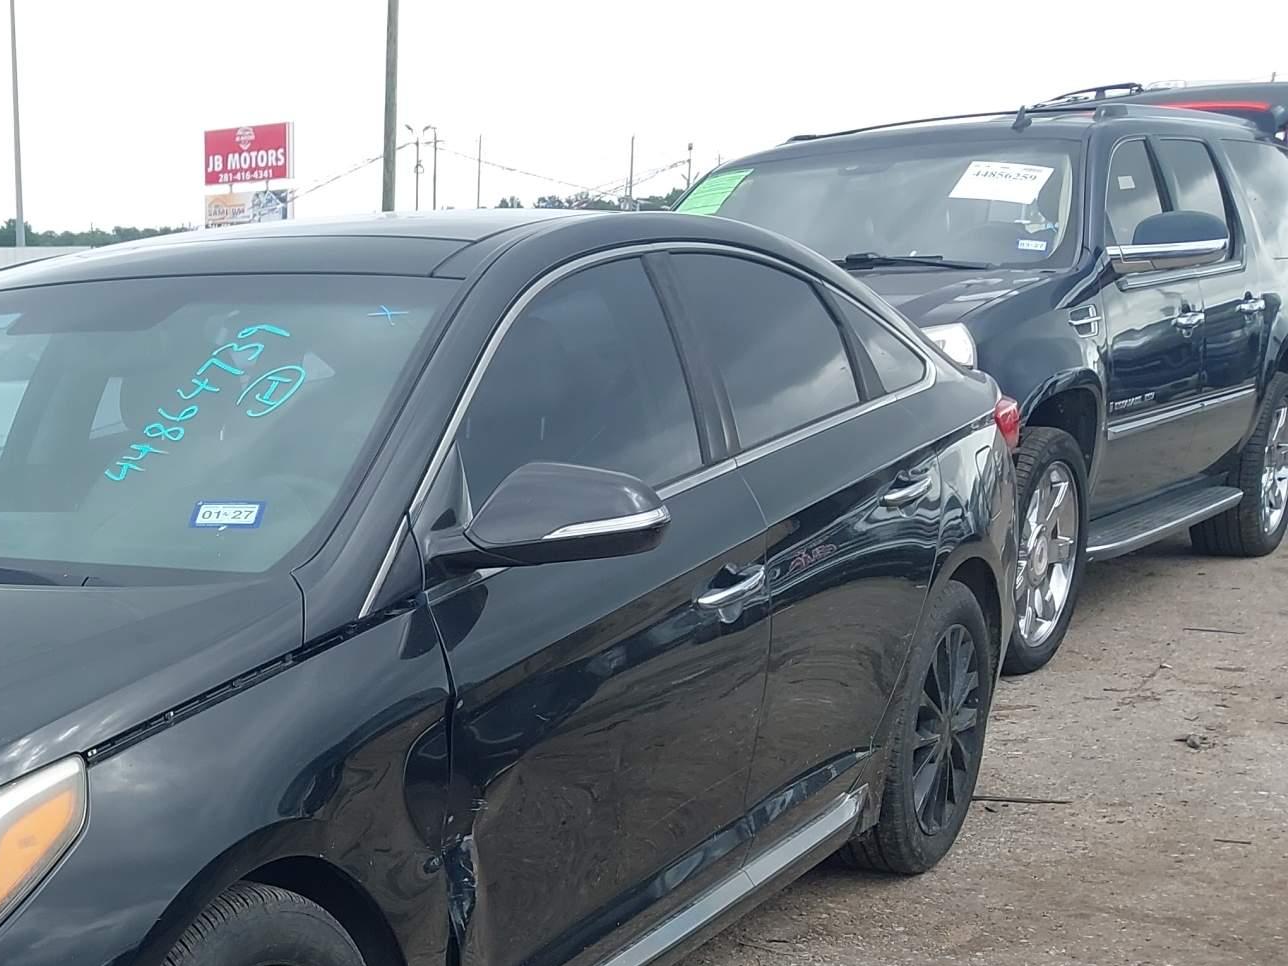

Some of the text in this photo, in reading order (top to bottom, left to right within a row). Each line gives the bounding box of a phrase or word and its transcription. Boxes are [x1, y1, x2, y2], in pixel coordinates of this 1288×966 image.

[208, 148, 285, 173] JB MOTORS
[972, 170, 1038, 181] 44856259
[104, 322, 291, 481] 44864739
